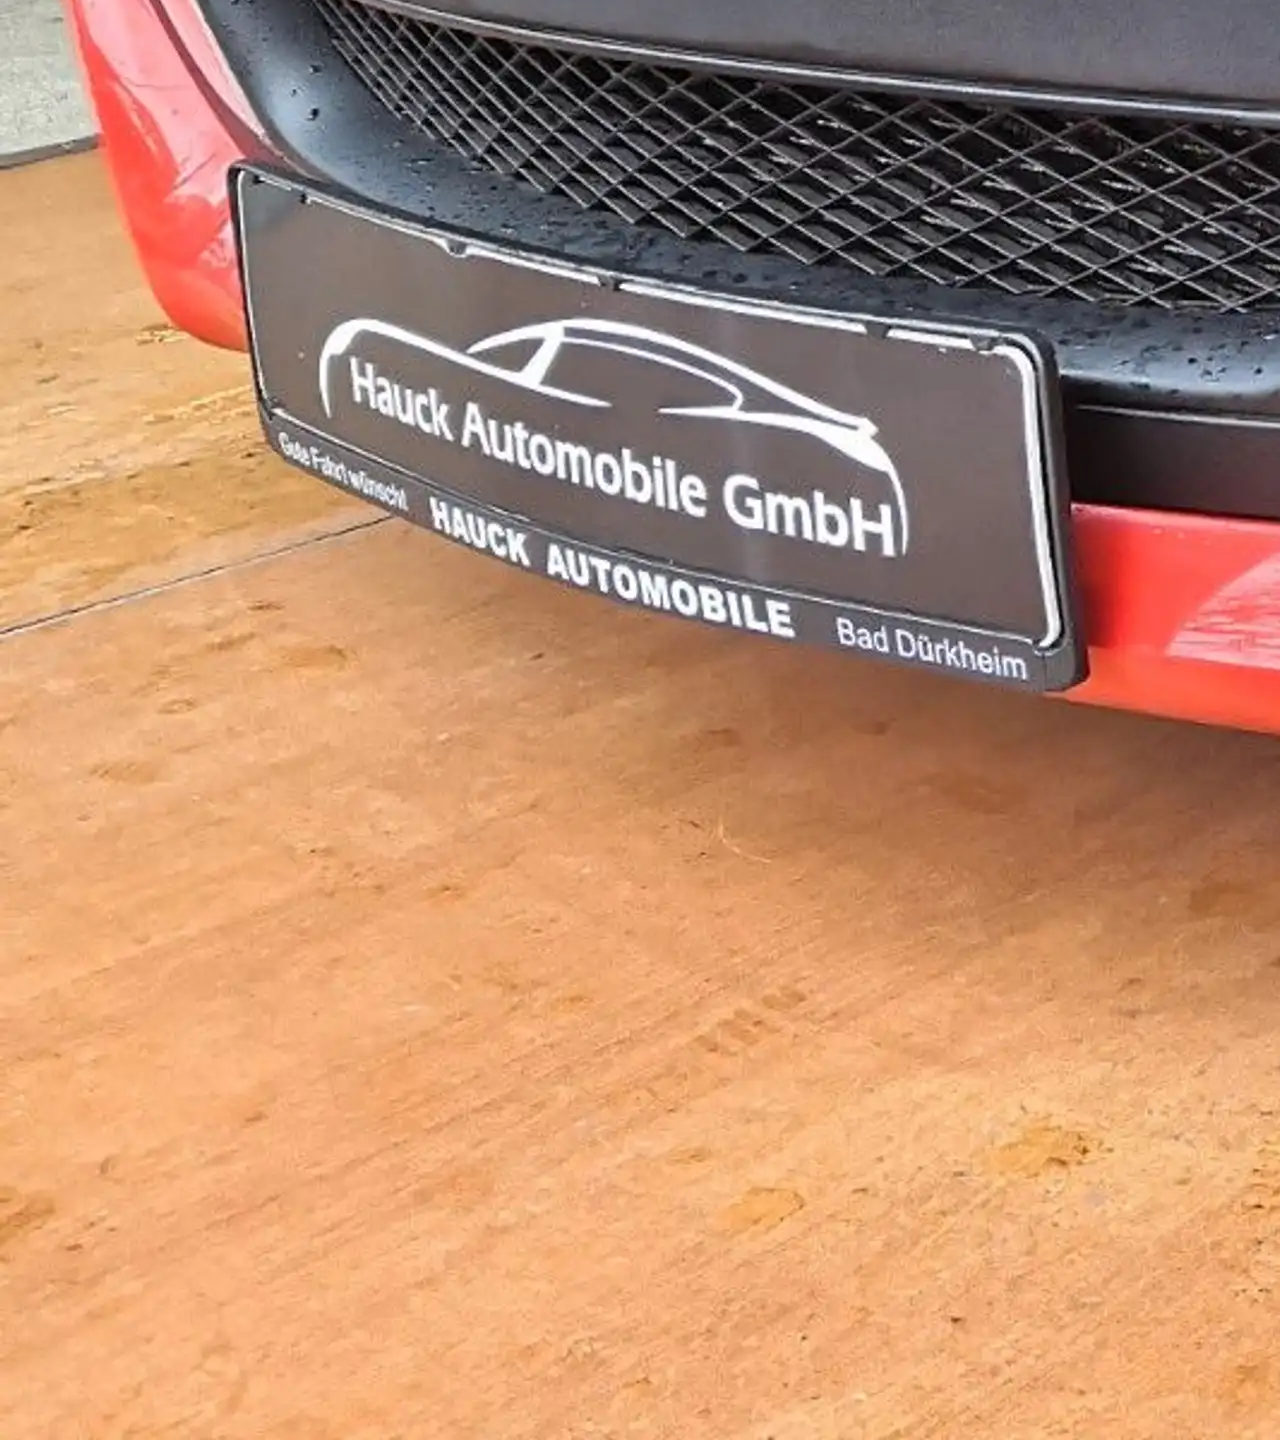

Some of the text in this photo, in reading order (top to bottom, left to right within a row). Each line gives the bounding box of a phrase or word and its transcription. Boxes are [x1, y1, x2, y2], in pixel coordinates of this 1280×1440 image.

[351, 357, 895, 557] Hauck Automobile GmbH
[429, 496, 530, 567] HAUCK
[546, 543, 795, 638] AUTOMOBILE
[836, 616, 1028, 681] Bad Dürkheim
